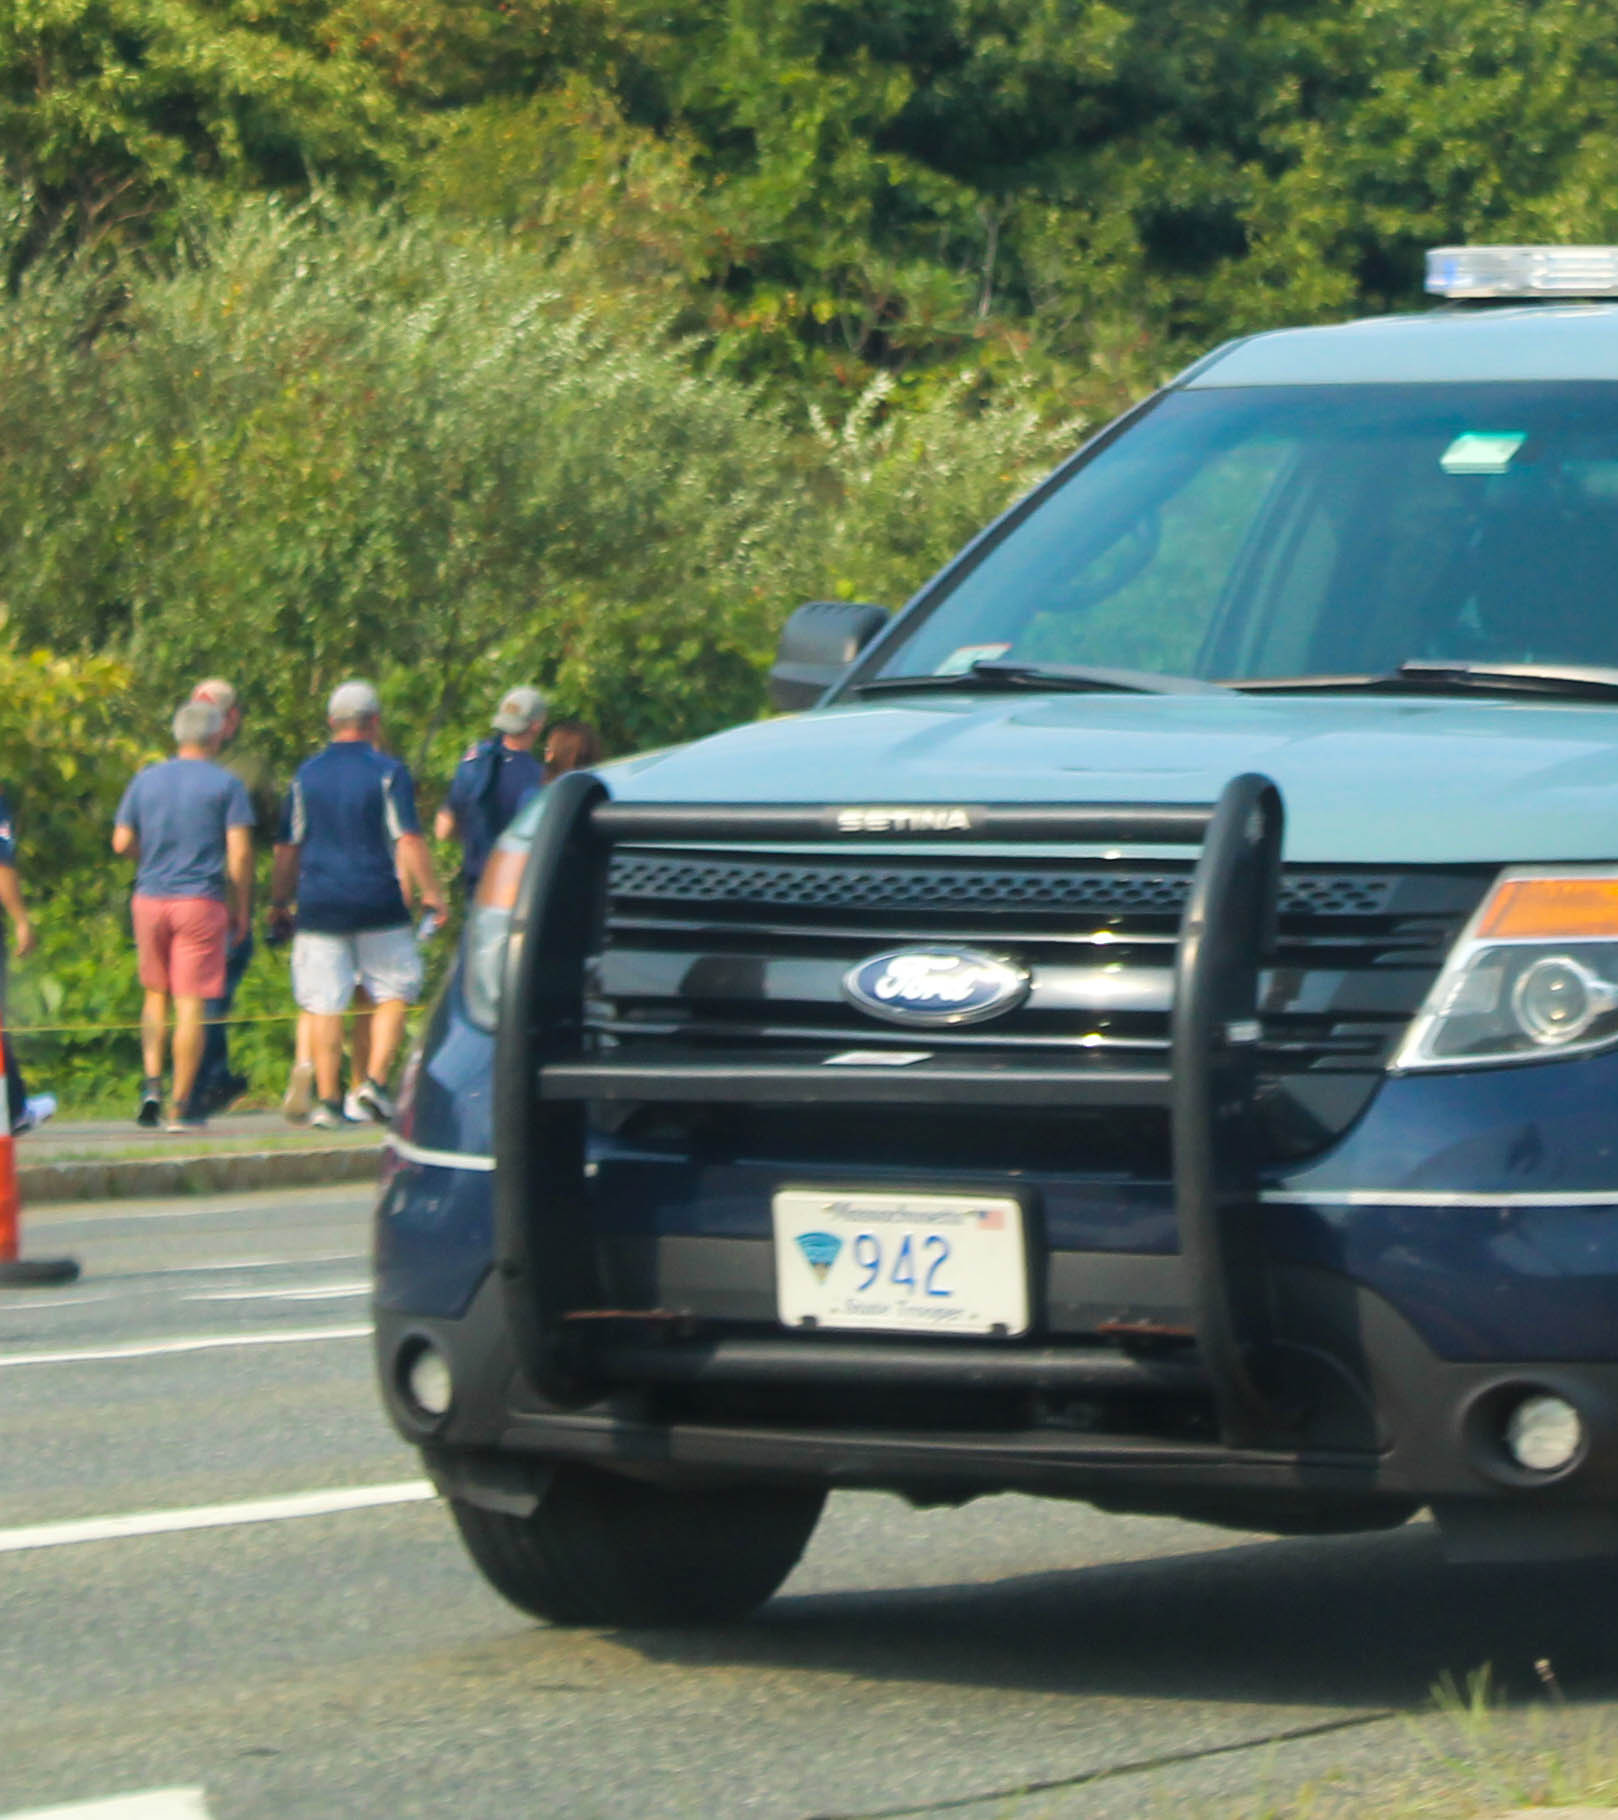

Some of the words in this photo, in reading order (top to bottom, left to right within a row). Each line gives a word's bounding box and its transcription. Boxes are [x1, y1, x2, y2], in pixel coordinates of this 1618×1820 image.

[837, 807, 971, 831] SETINA
[875, 955, 996, 1002] Ford
[853, 1231, 954, 1296] 942
